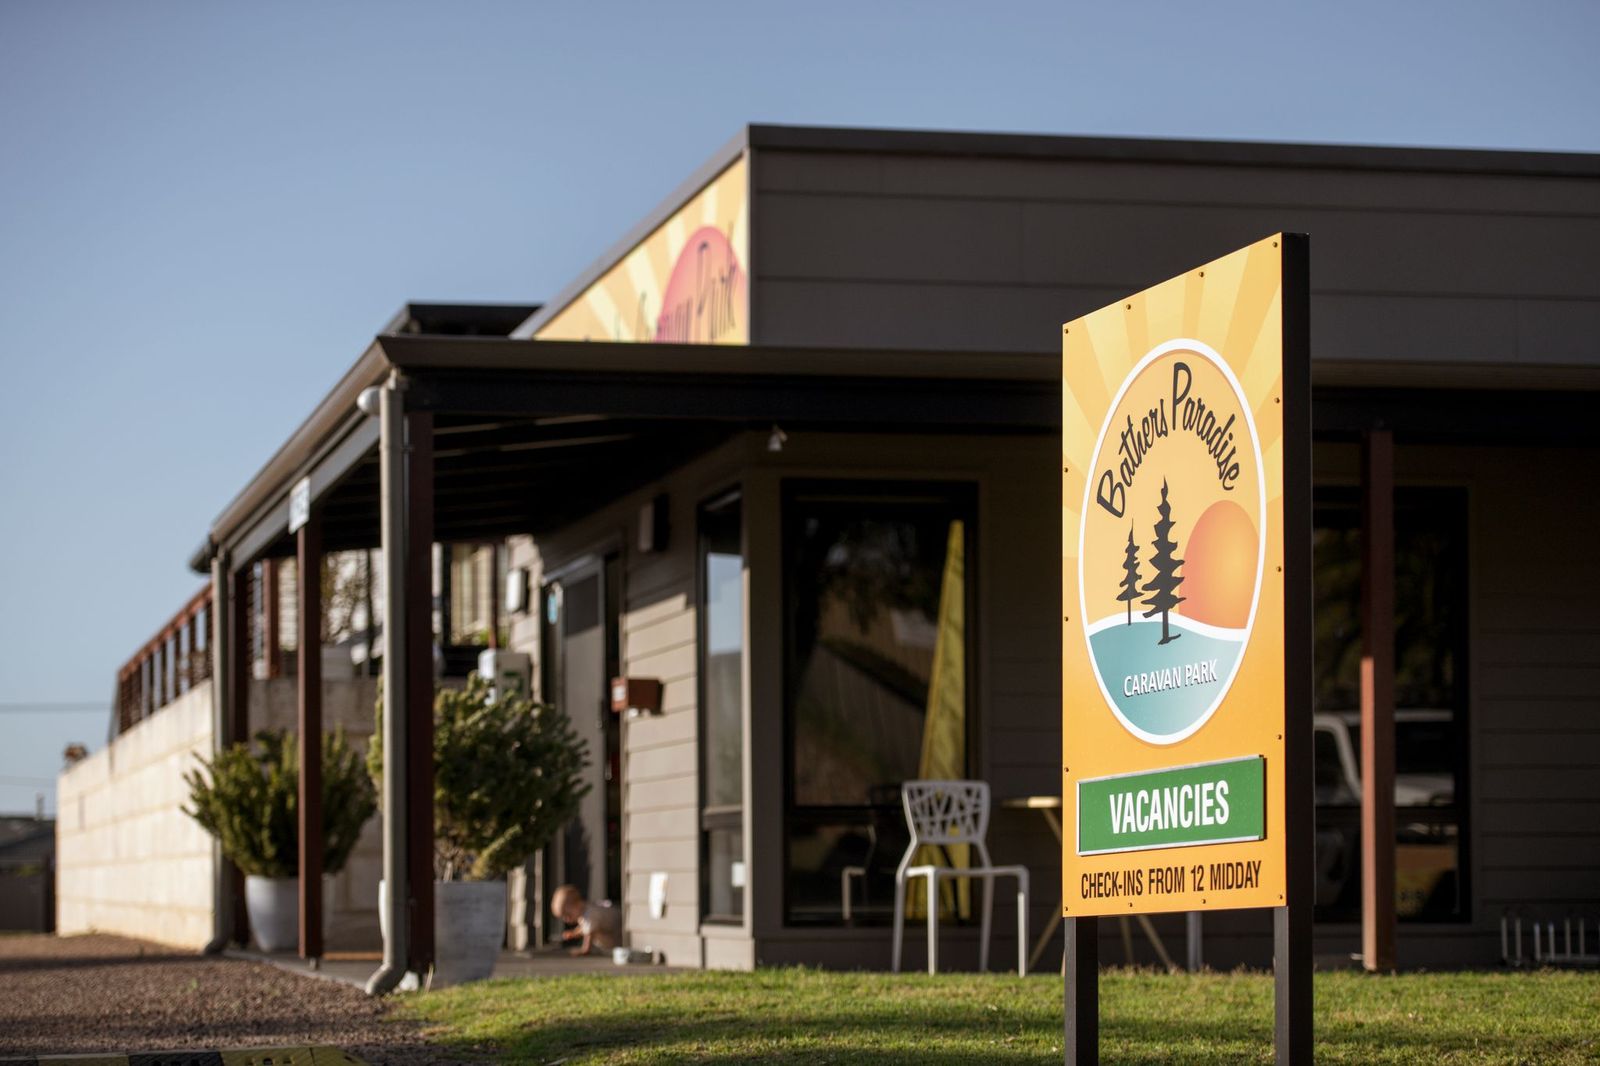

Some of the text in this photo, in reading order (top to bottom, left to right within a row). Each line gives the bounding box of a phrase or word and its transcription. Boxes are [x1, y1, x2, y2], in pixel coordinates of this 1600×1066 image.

[1097, 362, 1239, 518] Bathers Paradise
[1124, 659, 1217, 696] CARAVAN PARK
[1109, 780, 1230, 834] VACANCIES
[1081, 860, 1262, 899] CHECK-INS FROM 12 MIDDAY
